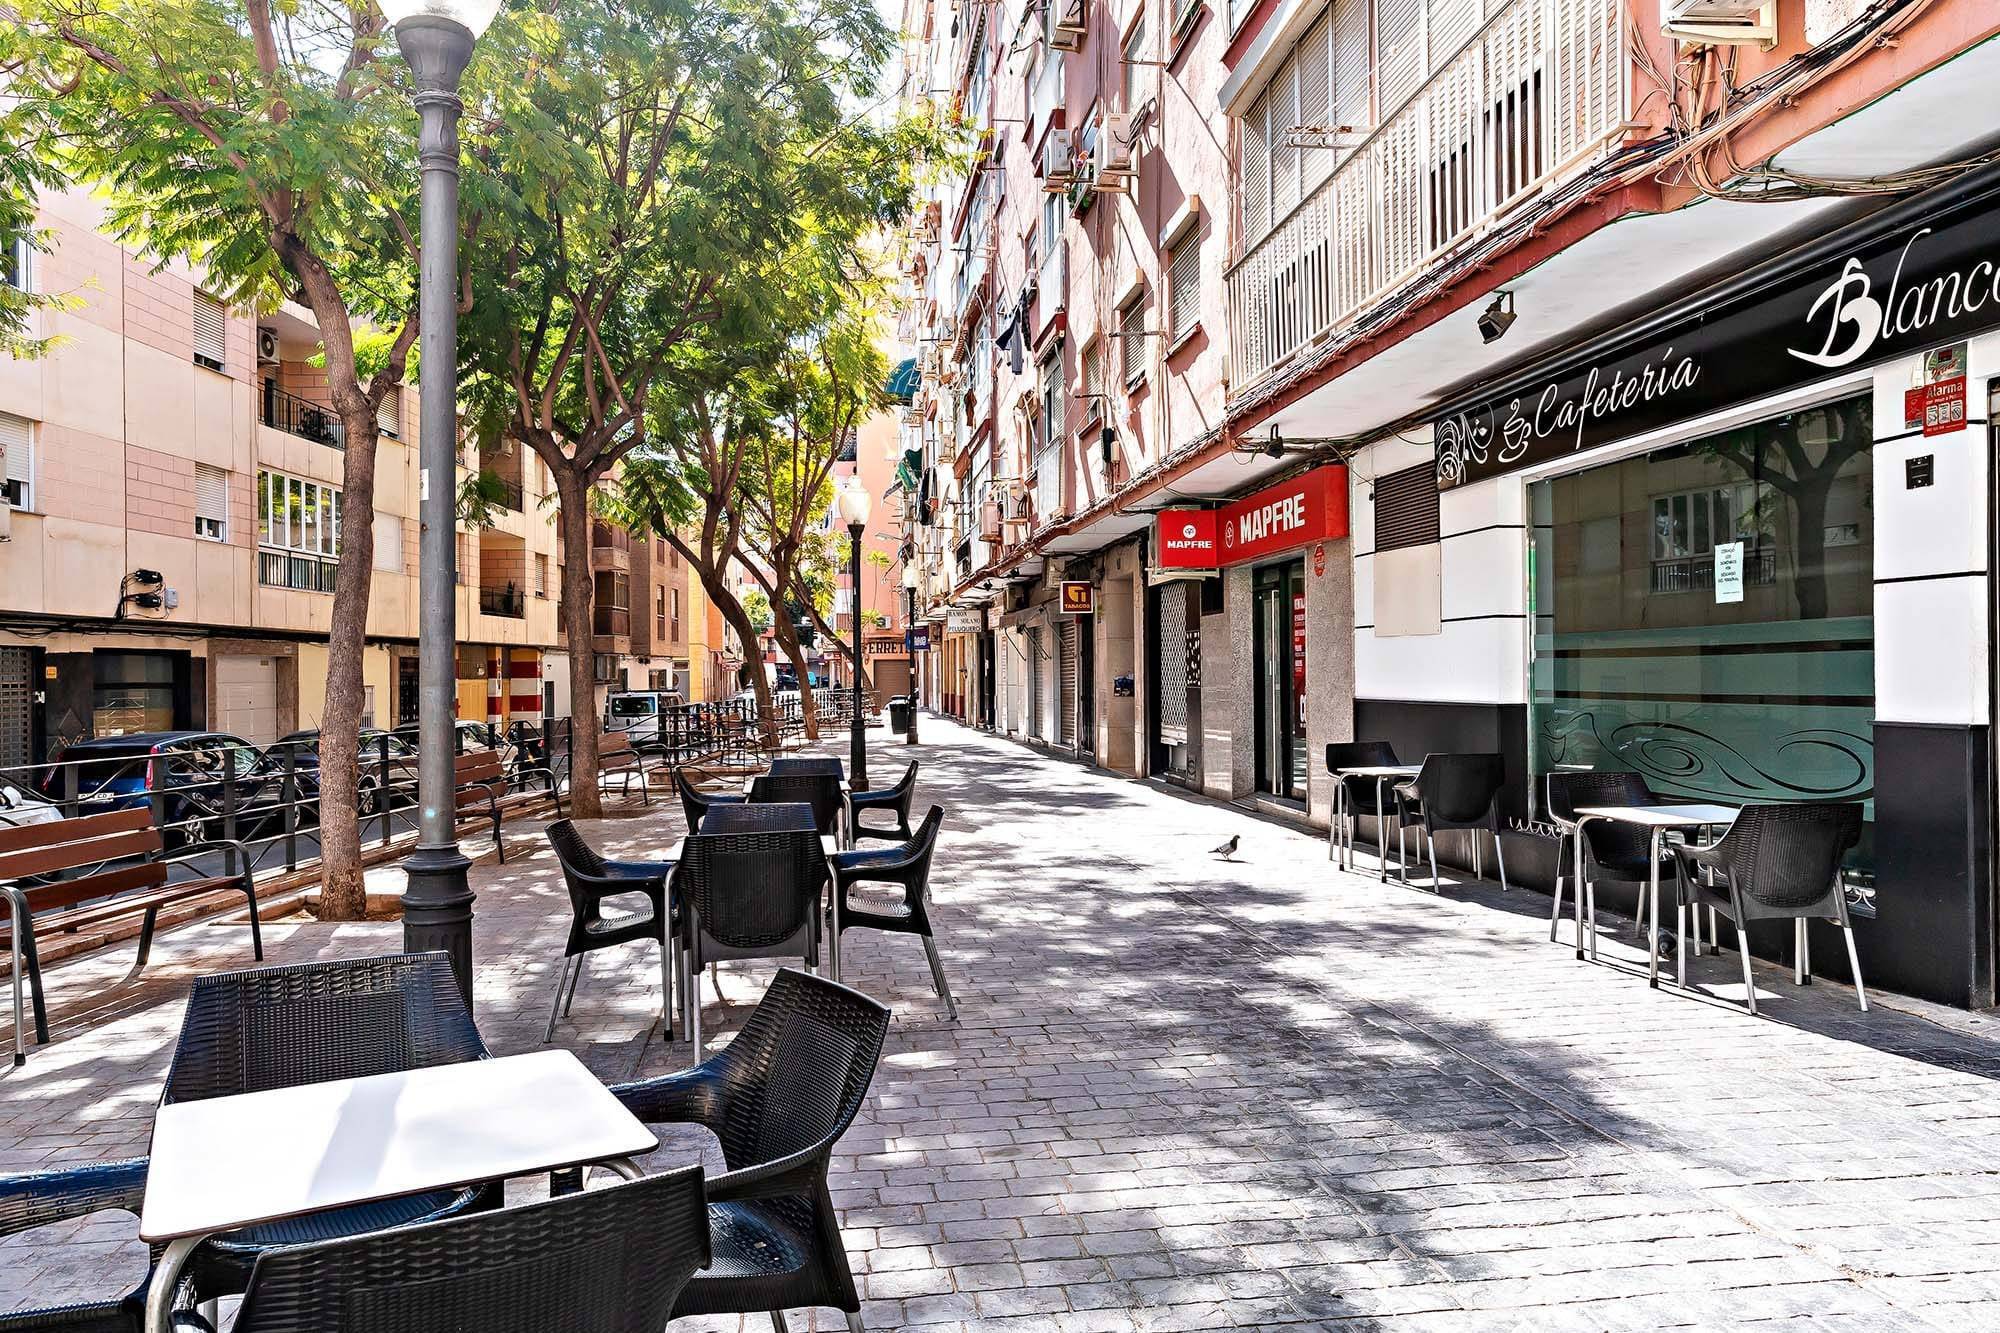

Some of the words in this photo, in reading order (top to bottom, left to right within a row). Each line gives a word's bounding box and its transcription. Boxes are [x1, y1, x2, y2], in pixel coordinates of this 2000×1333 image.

[1535, 347, 1700, 449] Cafetería
[1926, 382, 1963, 399] Alarma
[1240, 493, 1306, 545] MAPFRE
[1167, 540, 1213, 549] MAPFRE
